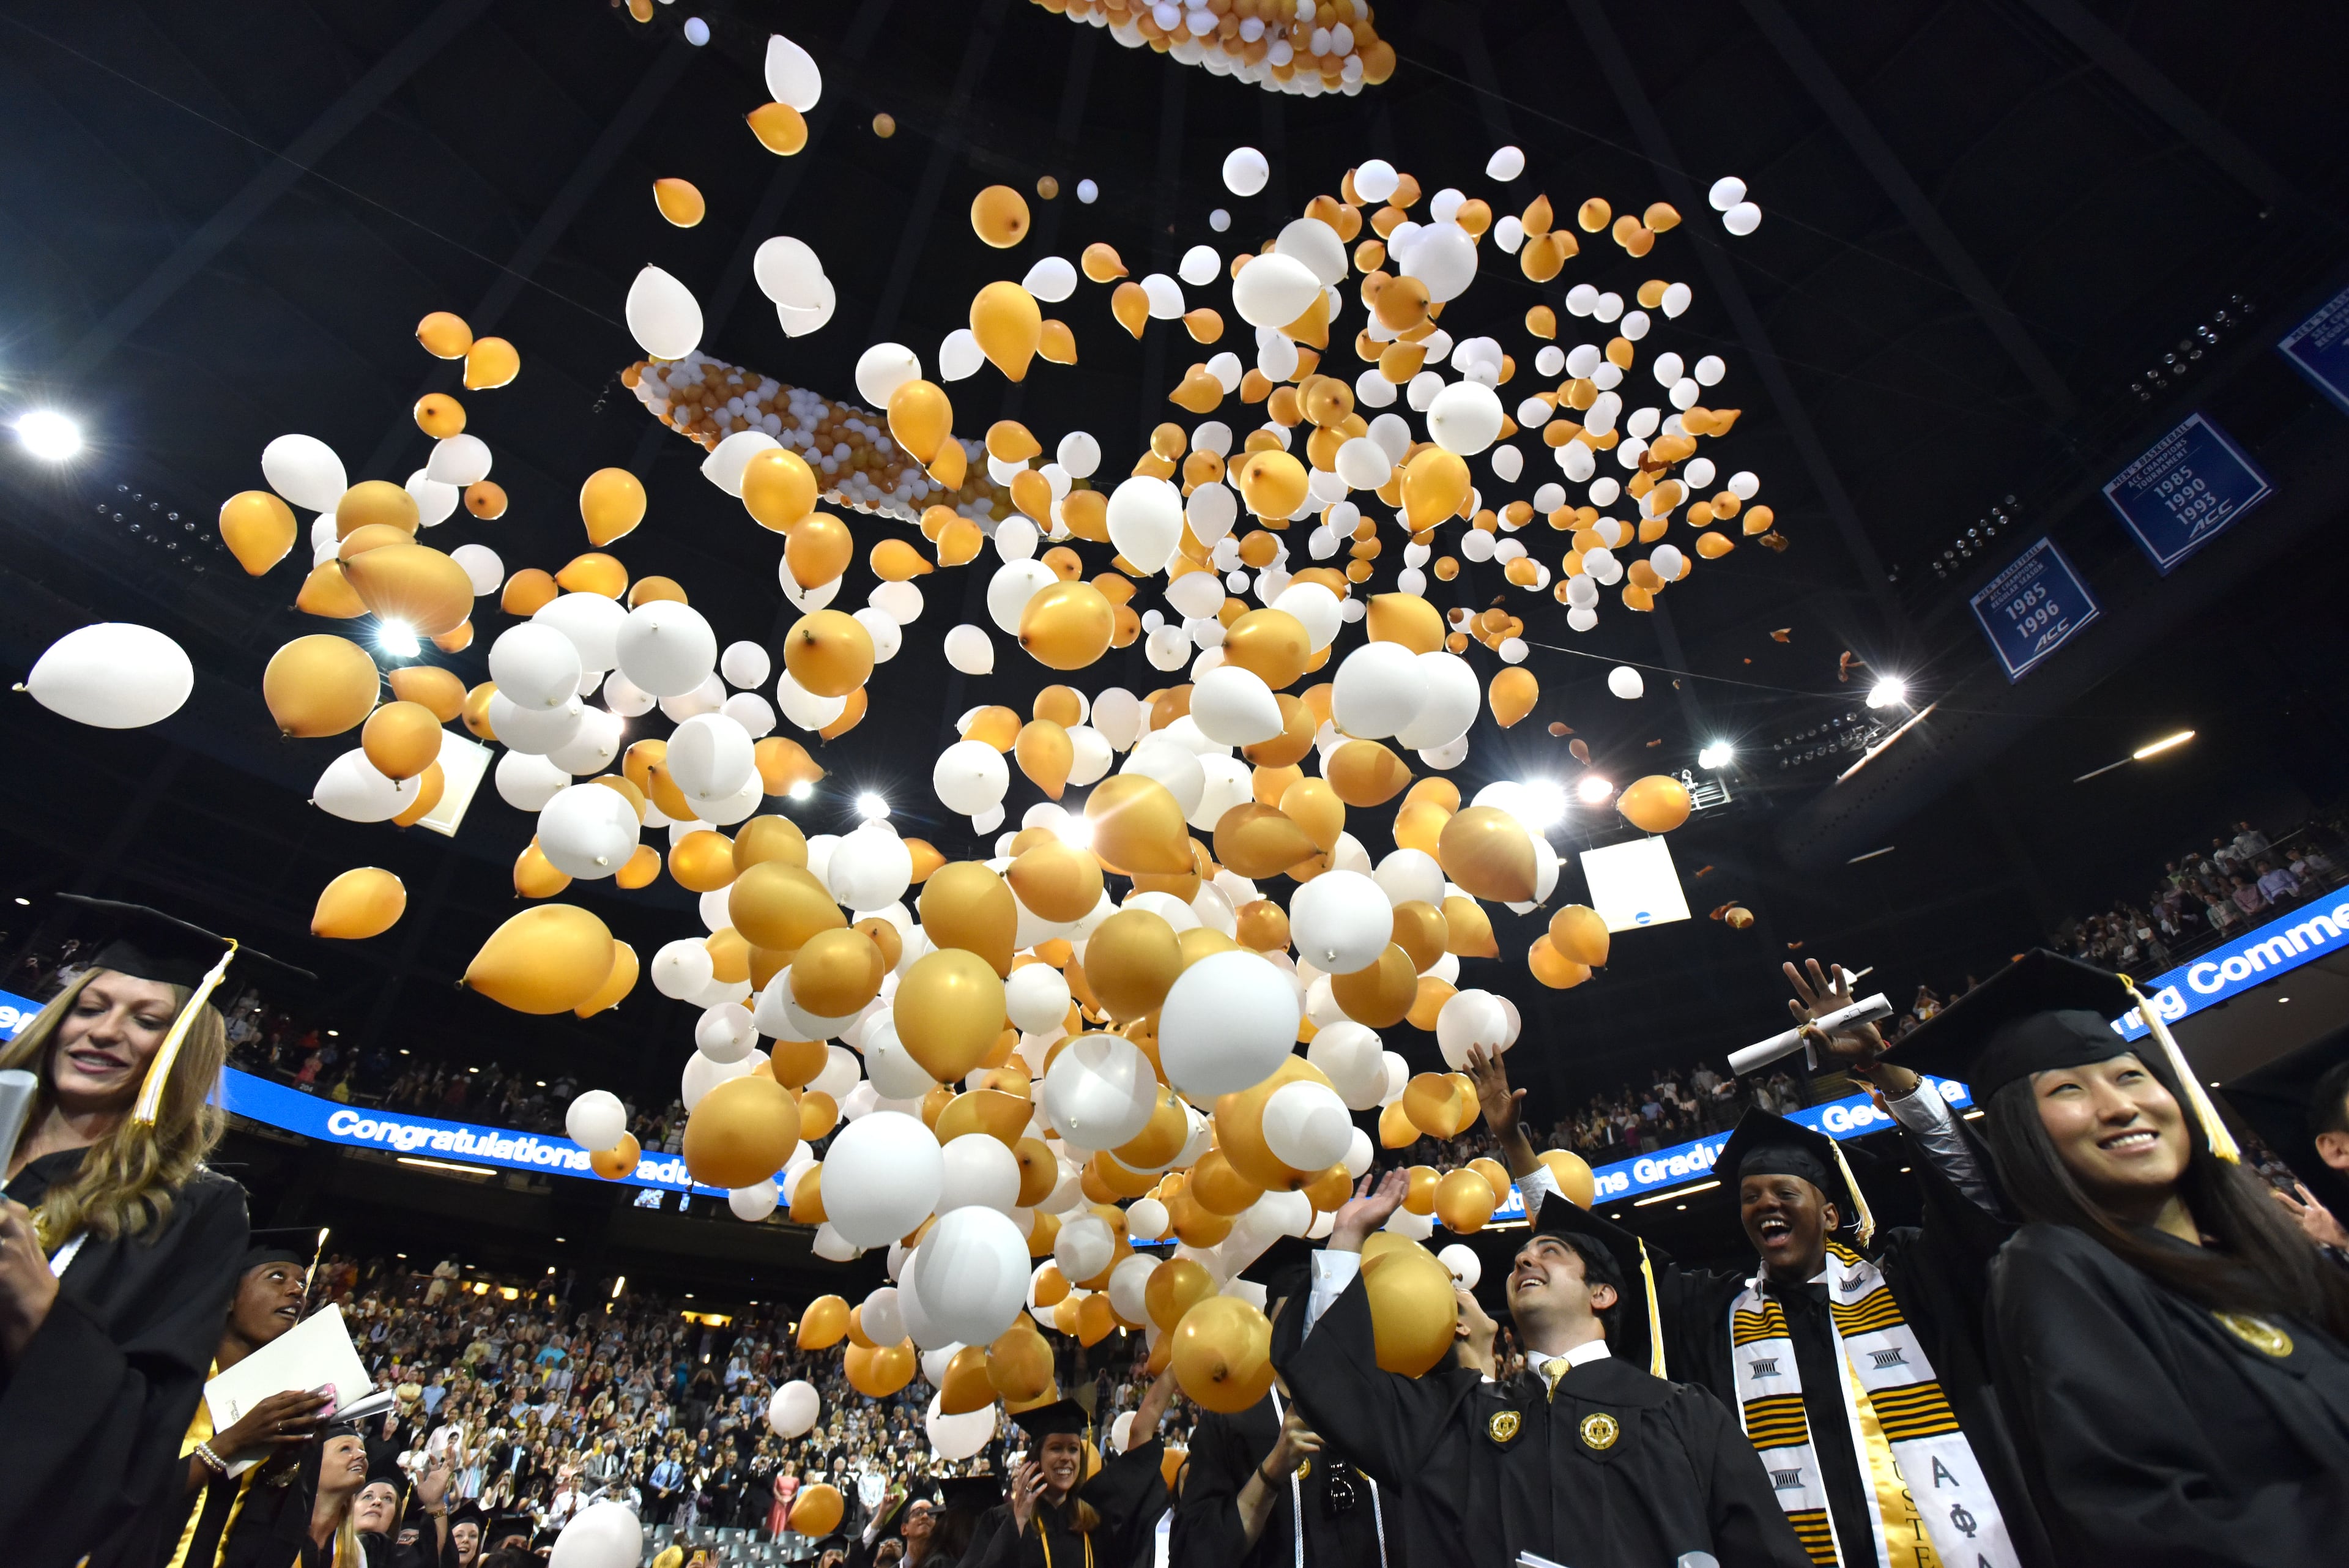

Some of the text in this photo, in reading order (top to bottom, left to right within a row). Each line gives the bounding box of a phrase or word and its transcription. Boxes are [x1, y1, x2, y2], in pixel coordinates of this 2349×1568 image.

[2112, 423, 2190, 488] MEN'S BASKETBALL
[2128, 437, 2188, 488] ACC CHAMPIONS
[2136, 447, 2188, 490] TOURNAMENT
[2153, 465, 2193, 499] 1985
[2165, 478, 2206, 512] 1990
[2176, 491, 2216, 525] 1993
[2188, 497, 2233, 540] ACC
[1978, 546, 2039, 600] MEN'S BASKETBALL
[1989, 559, 2038, 601] ACC CHAMPIONS
[1991, 562, 2044, 609] REGULAR SEASON
[2005, 582, 2046, 620] 1985
[2016, 600, 2059, 639] 1996
[2034, 617, 2069, 653] ACC
[328, 1110, 592, 1170] Congratulations
